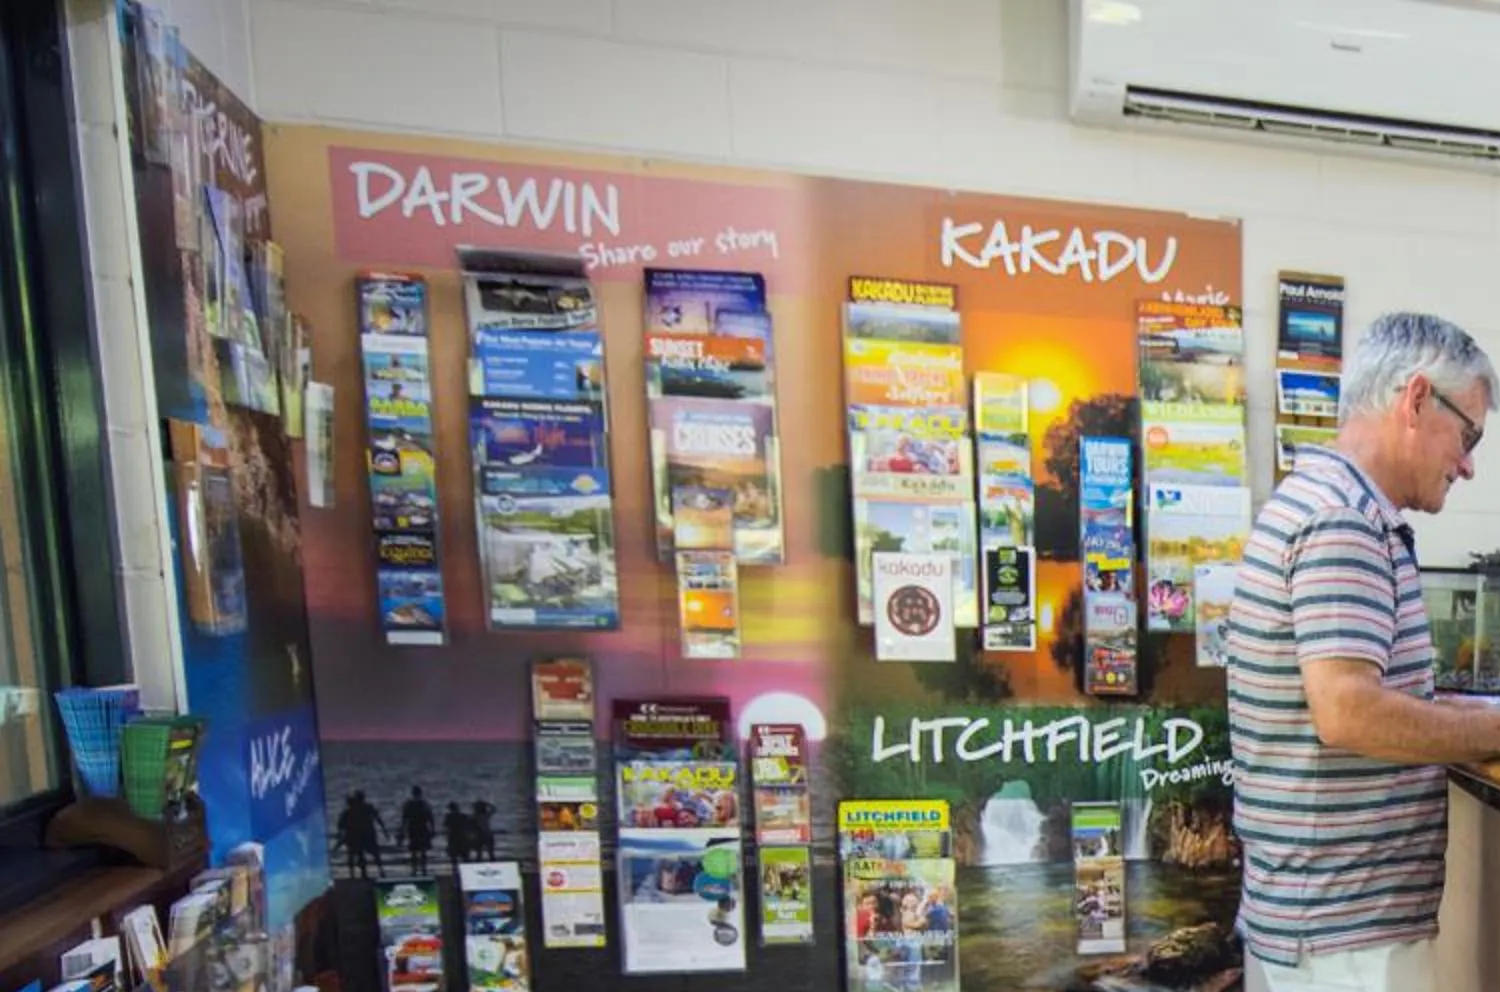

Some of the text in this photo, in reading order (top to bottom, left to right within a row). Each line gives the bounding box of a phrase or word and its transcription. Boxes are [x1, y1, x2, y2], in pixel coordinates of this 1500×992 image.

[349, 161, 621, 237] DARWIN
[579, 227, 779, 269] Share our story
[940, 217, 1179, 283] KAKADU
[879, 556, 944, 577] kakadu
[871, 715, 1204, 764] LITCHFIELD
[623, 767, 736, 782] KAKADU
[1140, 756, 1235, 791] Dreaming
[846, 810, 942, 823] LITCHFIELD
